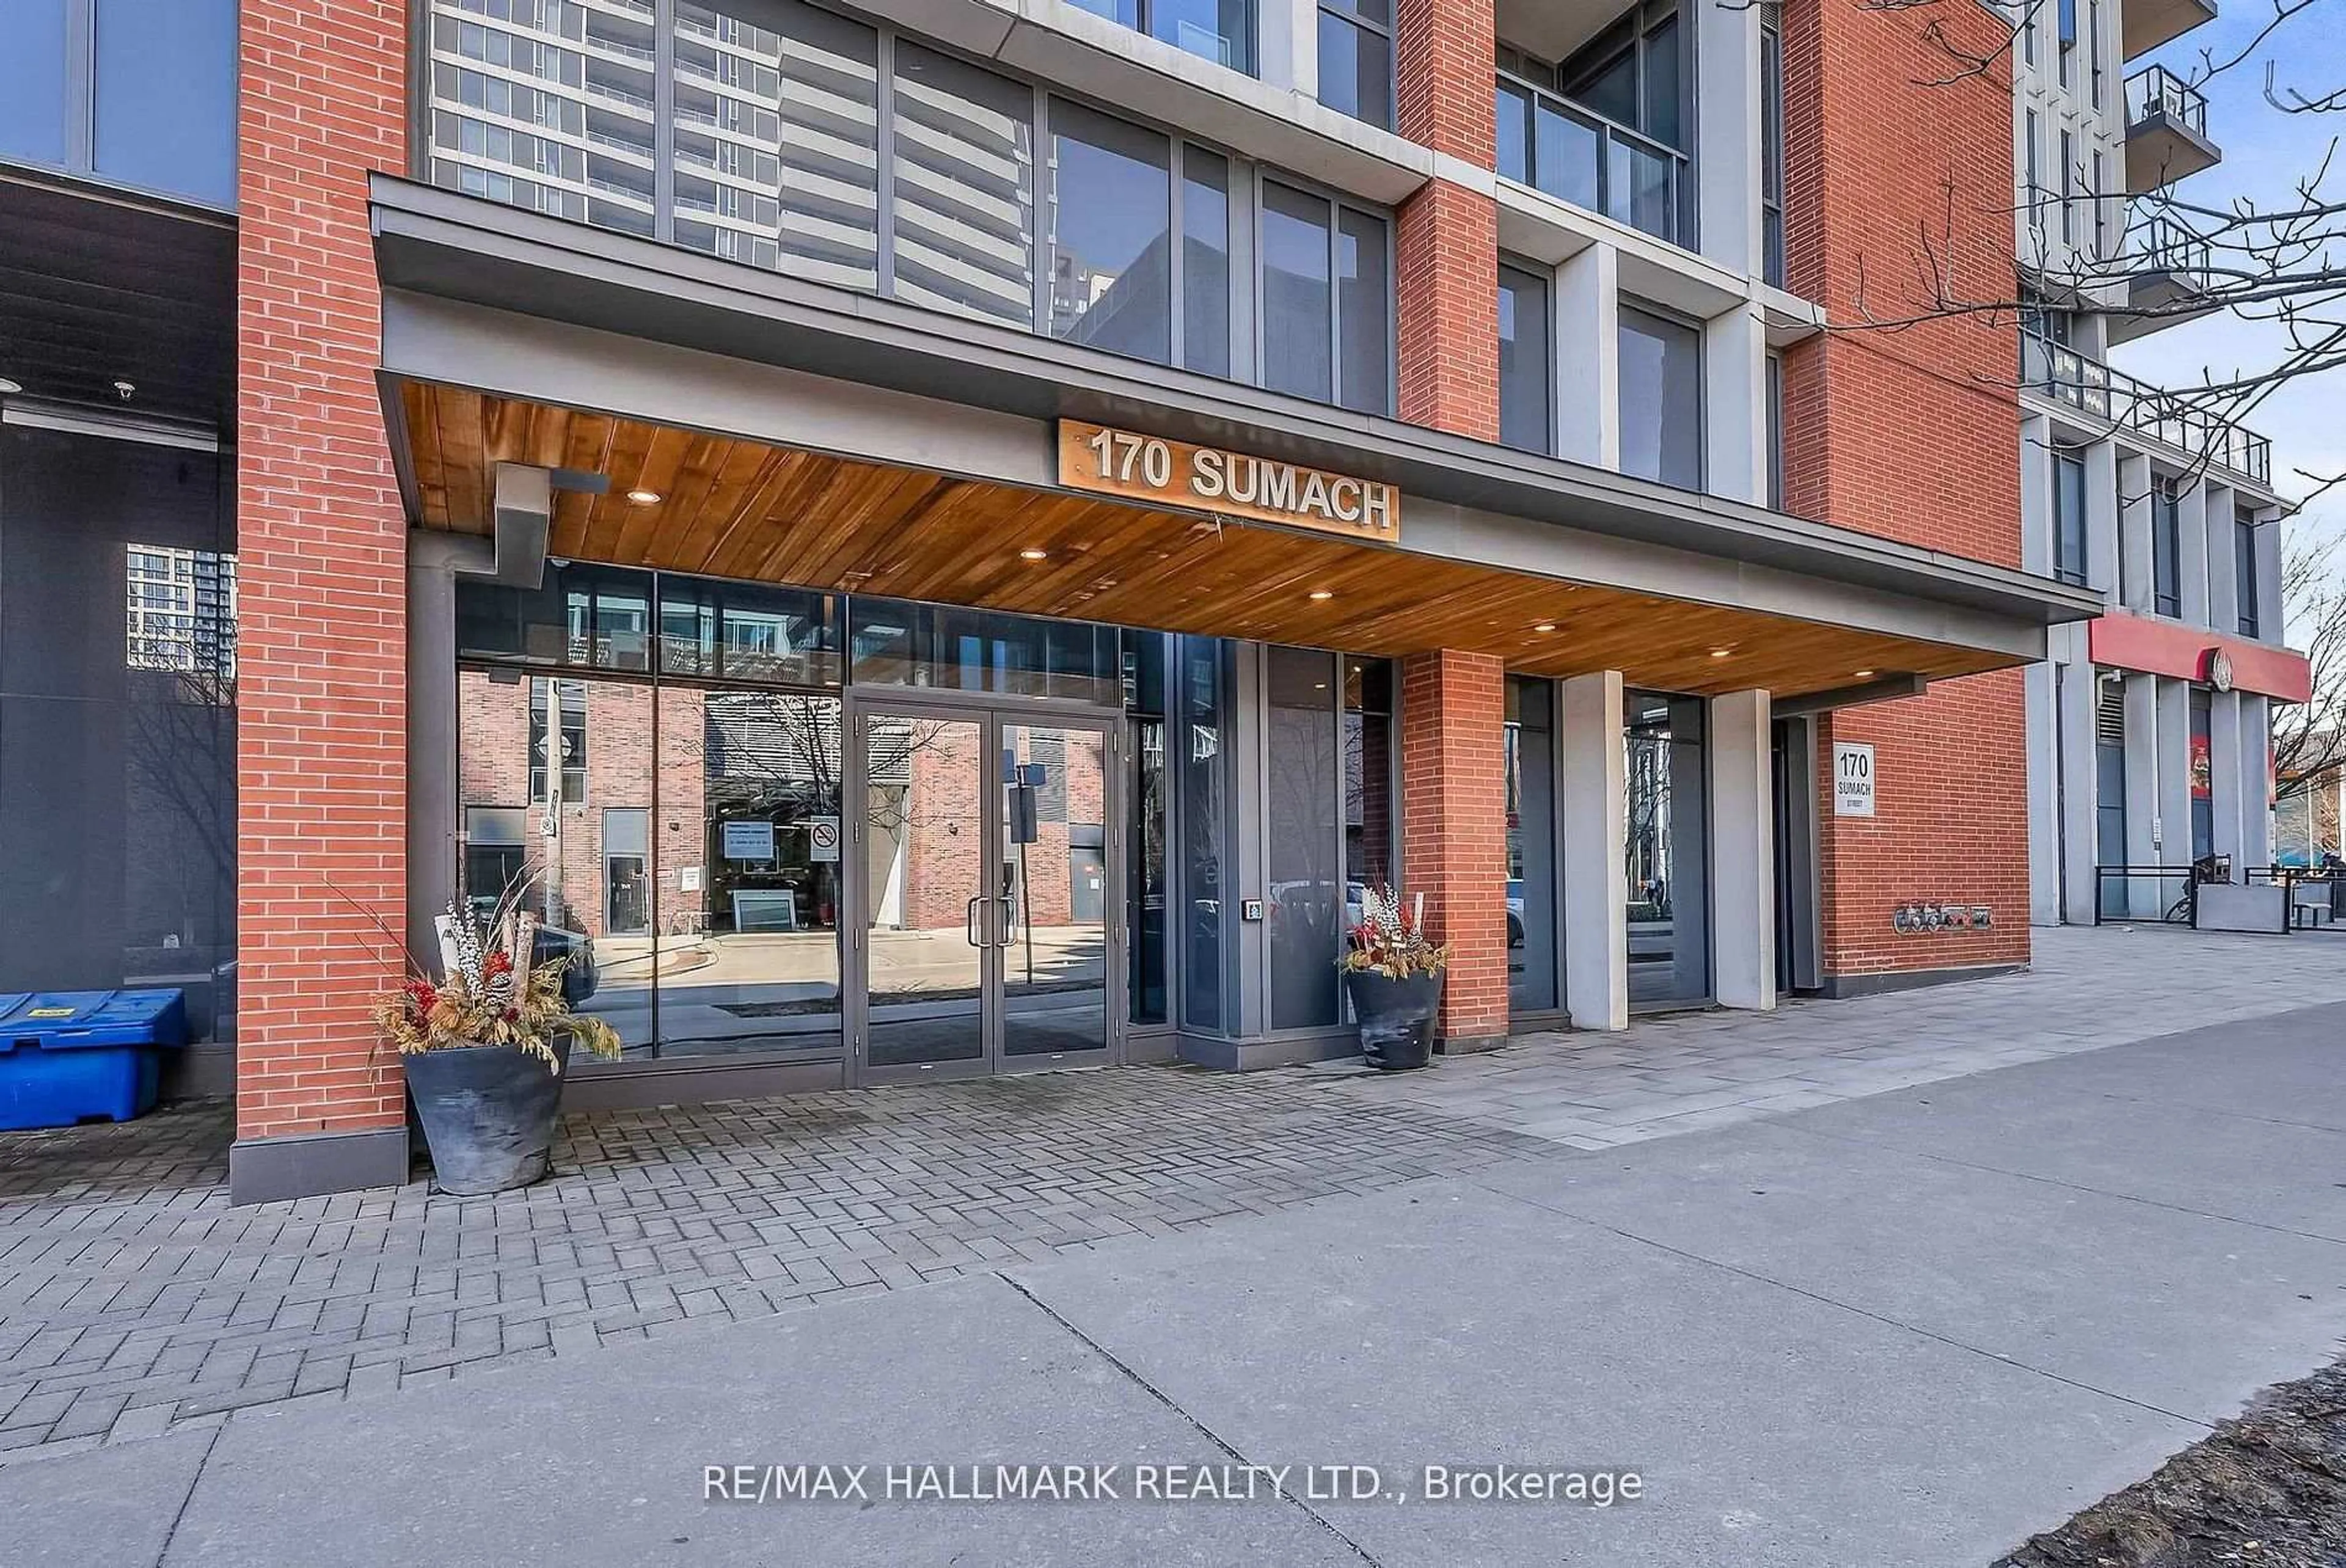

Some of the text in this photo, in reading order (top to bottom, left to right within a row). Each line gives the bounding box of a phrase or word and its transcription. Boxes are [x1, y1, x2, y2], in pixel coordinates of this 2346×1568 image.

[1091, 429, 1391, 528] 170 SUMACH
[1840, 752, 1868, 778] 170
[1838, 781, 1871, 796] SUMACH
